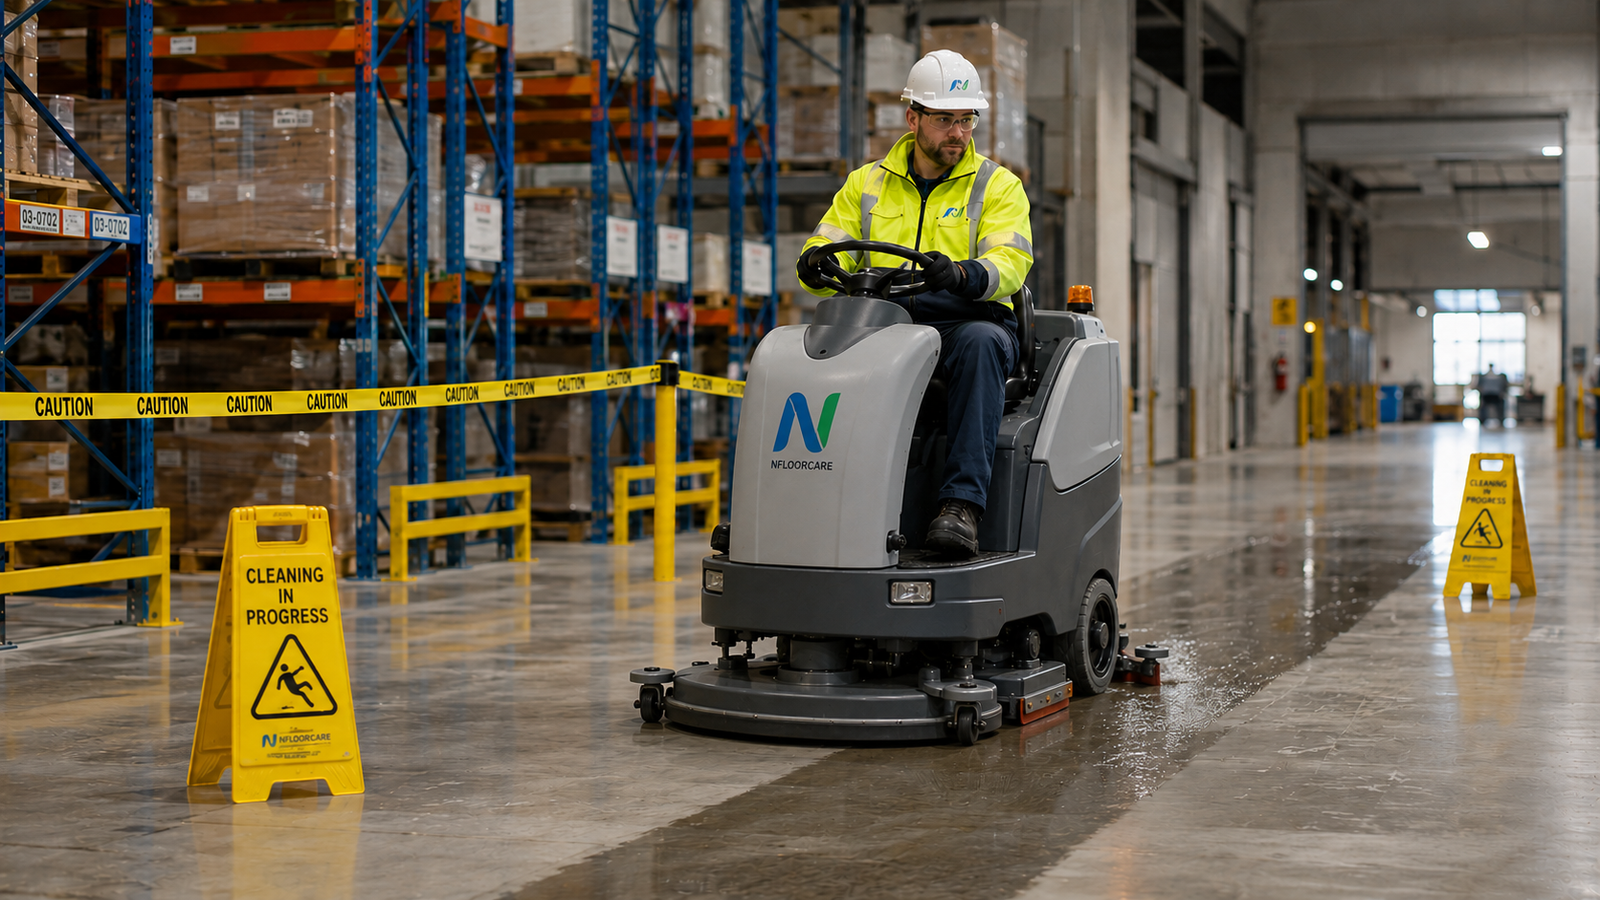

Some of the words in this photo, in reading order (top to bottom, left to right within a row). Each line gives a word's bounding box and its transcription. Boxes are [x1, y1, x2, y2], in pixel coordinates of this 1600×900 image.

[22, 209, 57, 227] 03-0702
[94, 217, 128, 235] 03-0702
[35, 396, 93, 417] CAUTION
[137, 396, 189, 415] CAUTION
[226, 394, 273, 413] CAUTION
[307, 392, 348, 410] CAUTION
[379, 389, 417, 407] CAUTION
[445, 385, 479, 403] CAUTION
[504, 381, 535, 397] CAUTION
[557, 376, 586, 392] CAUTION
[770, 459, 833, 471] NFLOORCARE
[1470, 479, 1507, 488] CLEANING
[1466, 496, 1506, 505] PROGRESS
[246, 566, 324, 584] CLEANING
[278, 588, 294, 604] IN
[246, 607, 329, 625] PROGRESS
[279, 733, 331, 744] NFLOORCARE
